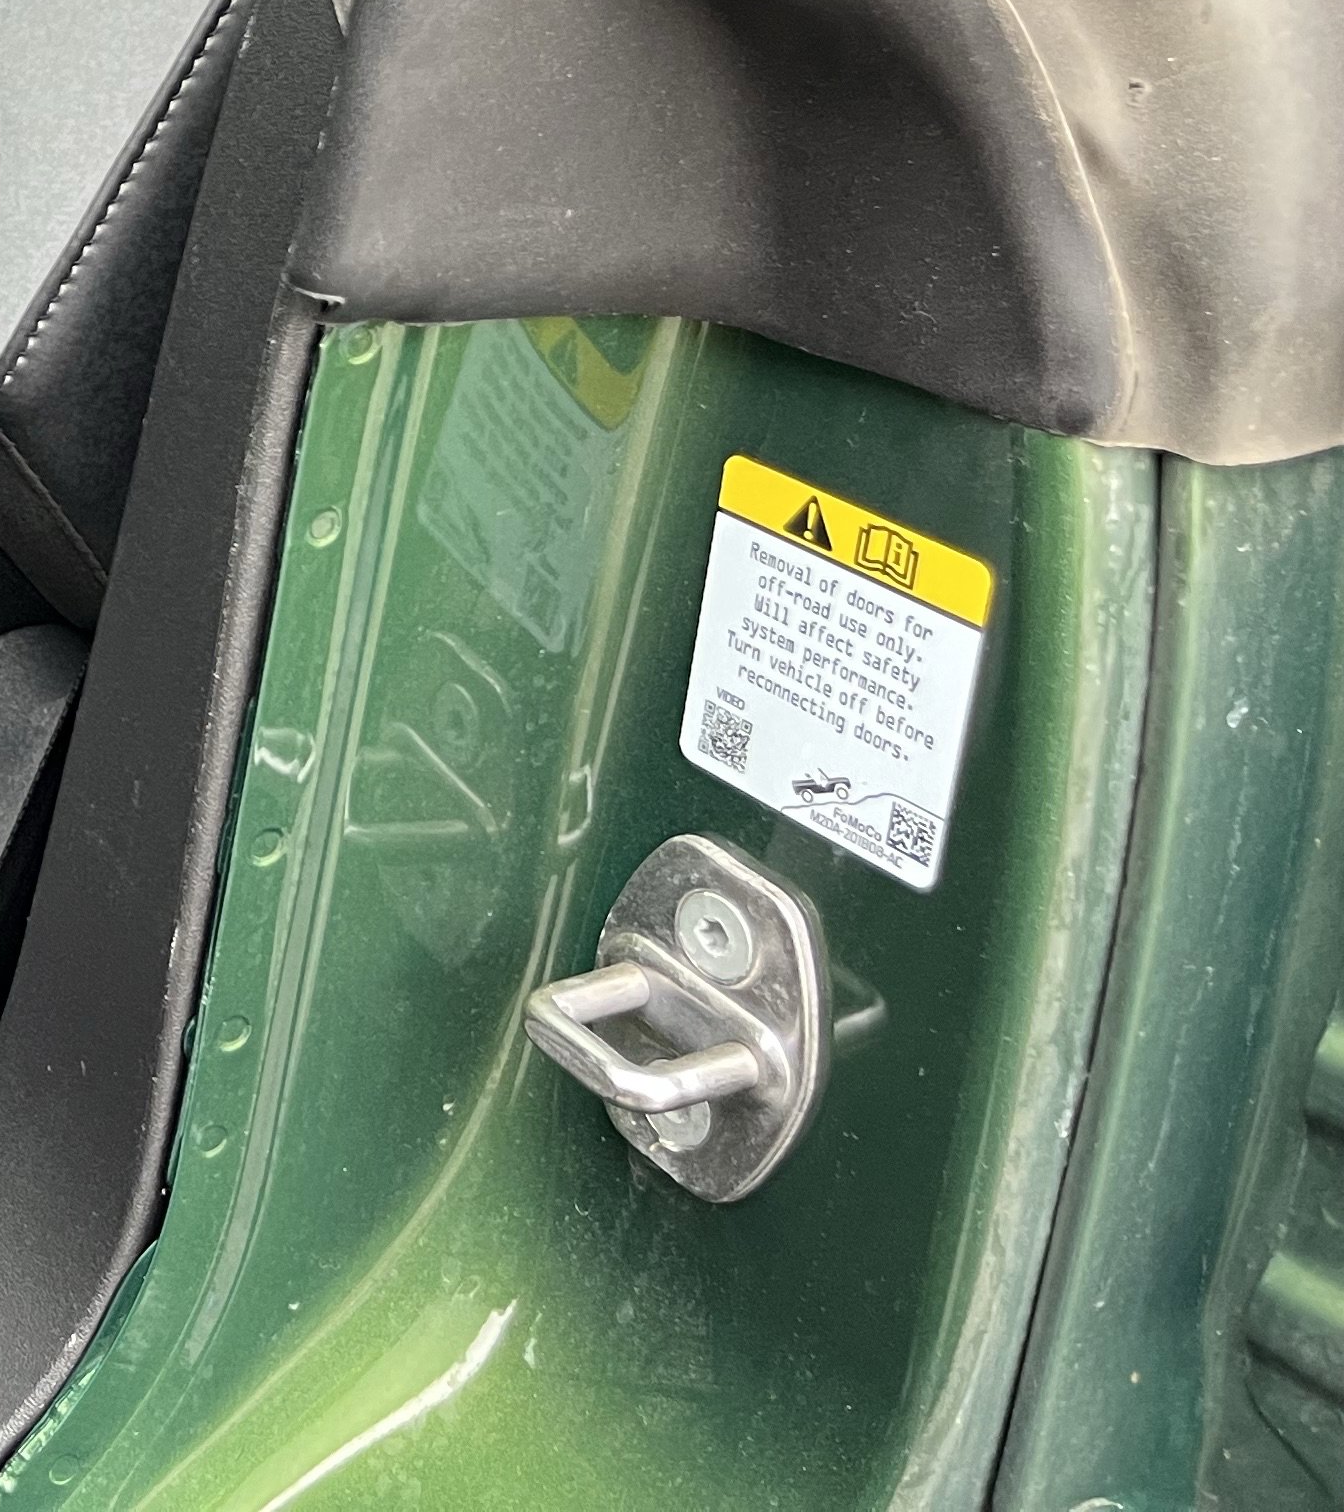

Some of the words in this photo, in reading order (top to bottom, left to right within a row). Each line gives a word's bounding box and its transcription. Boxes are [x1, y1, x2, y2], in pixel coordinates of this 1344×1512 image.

[749, 541, 812, 586] Removal
[818, 578, 839, 597] of
[846, 589, 894, 624] doors
[904, 615, 933, 641] for
[758, 575, 831, 620] off-road
[839, 613, 868, 638] use
[876, 631, 923, 664] only.
[727, 629, 761, 662] Turn
[769, 655, 833, 698] vehicle
[839, 691, 868, 715] off
[875, 704, 934, 750] before
[741, 616, 795, 653] system
[802, 647, 914, 711] performance.
[754, 593, 789, 626] Will
[798, 620, 854, 657] affect
[862, 650, 921, 693] safety
[716, 686, 746, 711] VIDEO
[738, 664, 846, 734] reconnecting
[853, 722, 909, 762] doors.
[833, 807, 882, 842] FoMoCo
